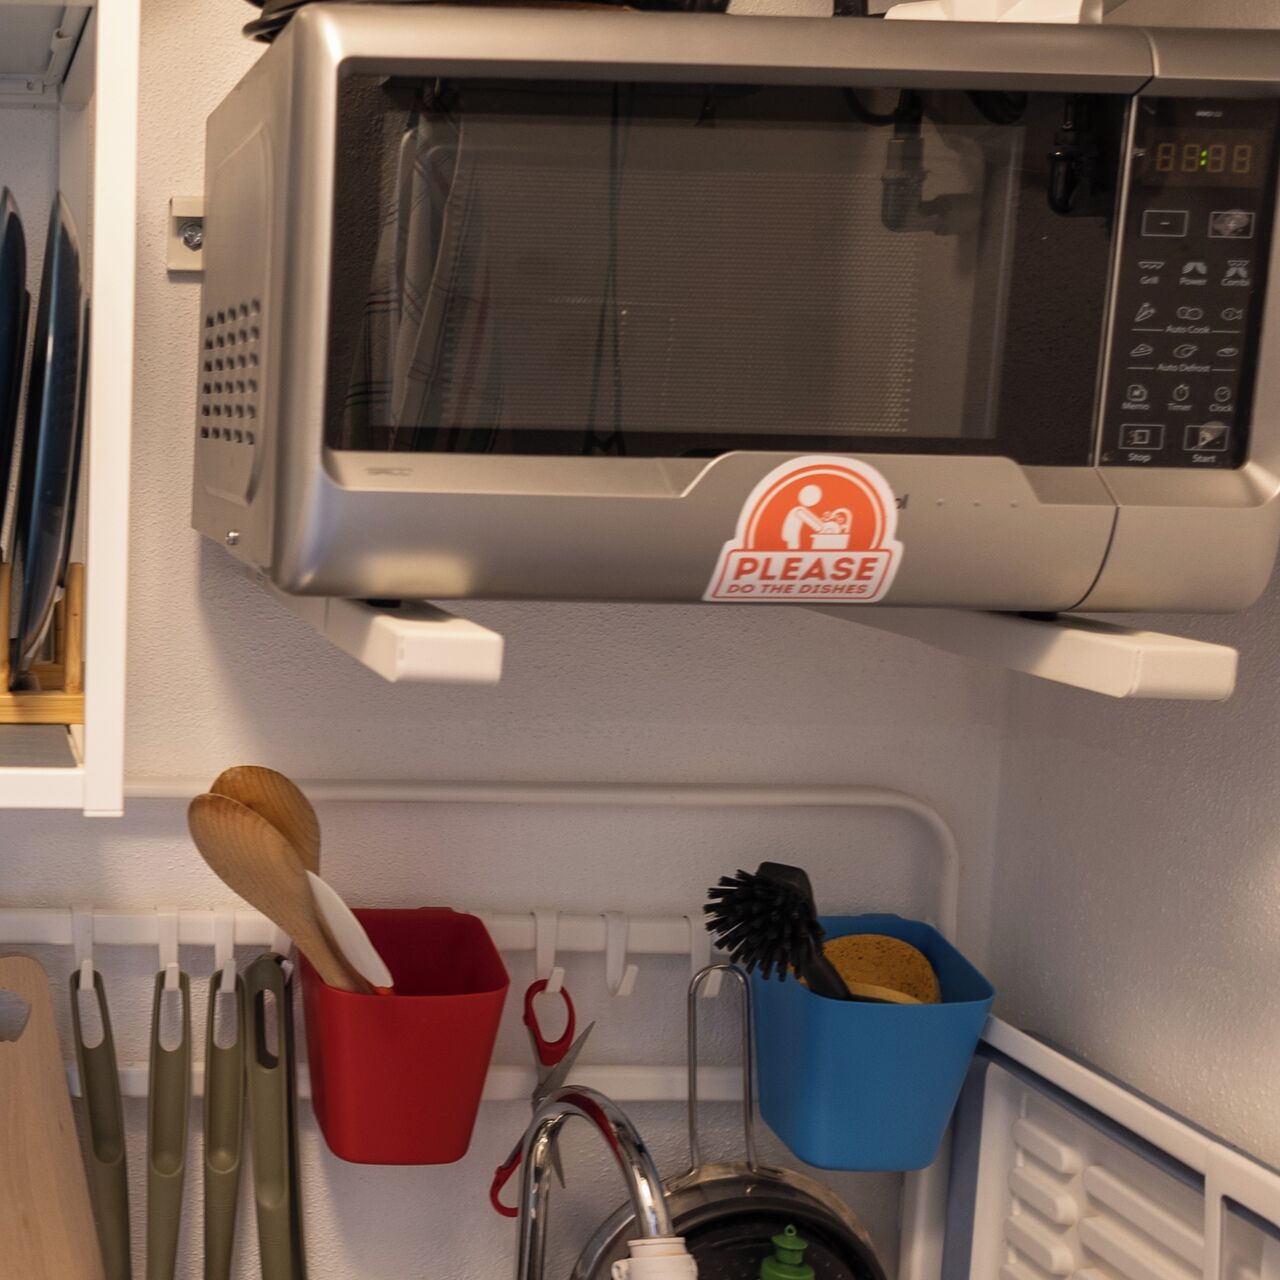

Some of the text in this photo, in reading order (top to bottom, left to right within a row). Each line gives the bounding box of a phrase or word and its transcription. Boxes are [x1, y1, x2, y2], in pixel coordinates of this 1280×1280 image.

[1128, 453, 1216, 464] Stop Start
[732, 557, 879, 581] PLEASE
[726, 584, 868, 594] DO THE DISHES
